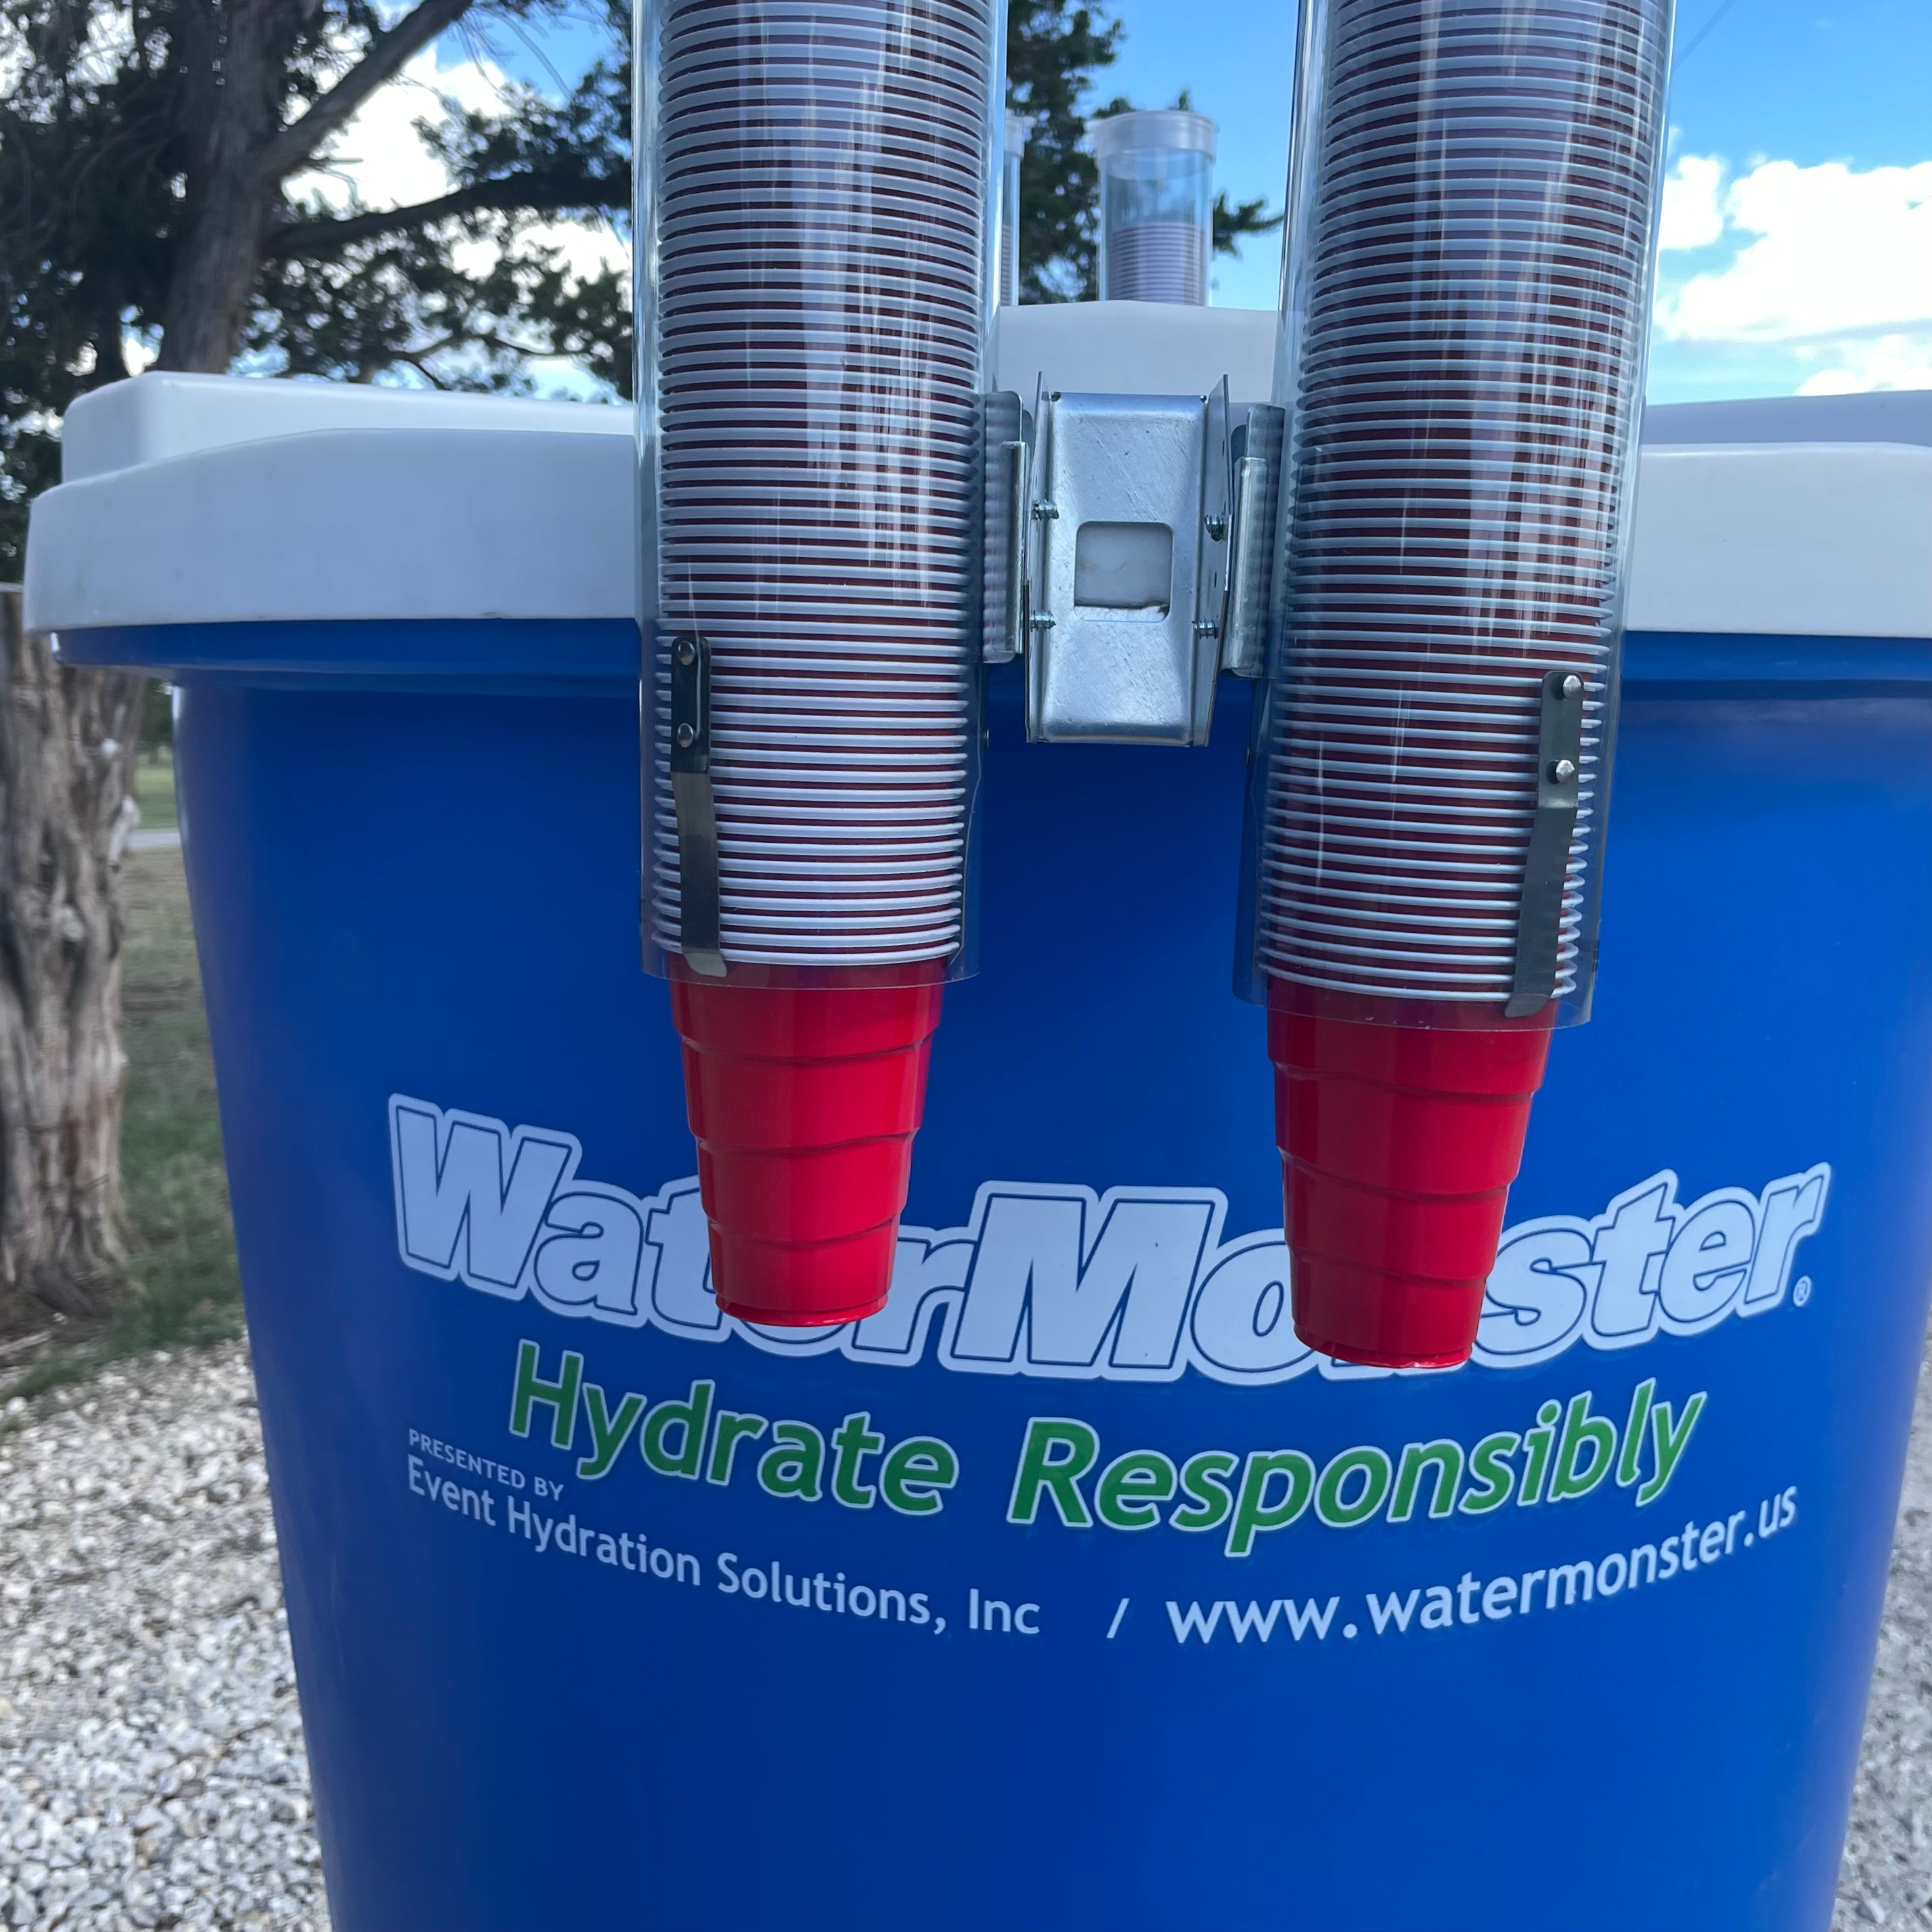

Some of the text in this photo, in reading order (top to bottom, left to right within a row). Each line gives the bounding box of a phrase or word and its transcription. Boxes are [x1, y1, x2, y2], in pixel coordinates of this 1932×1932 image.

[409, 1428, 565, 1501] PRESENTED BY
[509, 1338, 1709, 1558] Hydrate Responsibly
[408, 1455, 1798, 1644] Event Hydration Solutions, Inc / www.watermonster.us
